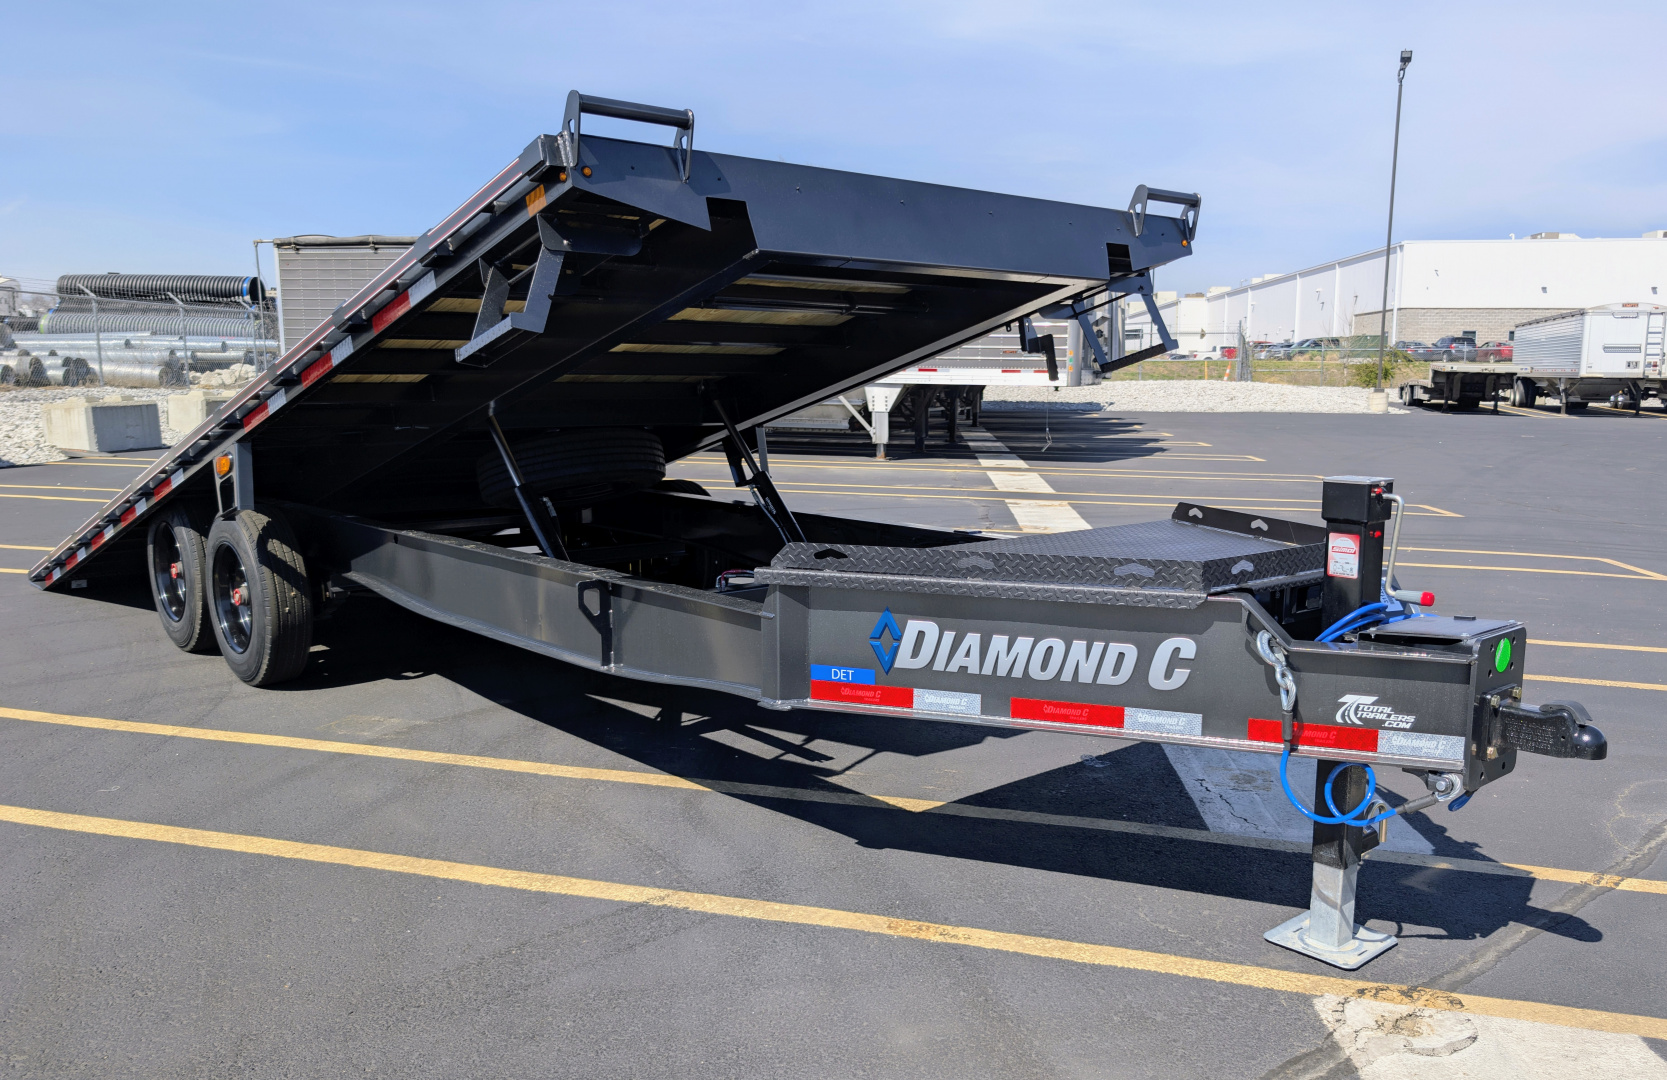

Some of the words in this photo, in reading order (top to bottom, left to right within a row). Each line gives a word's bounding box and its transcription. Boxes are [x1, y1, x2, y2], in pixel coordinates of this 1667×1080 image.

[894, 620, 1138, 686] DIAMOND
[1147, 637, 1197, 691] C
[831, 668, 855, 681] DET
[845, 687, 875, 698] DIAMOND
[875, 690, 882, 698] C
[929, 695, 960, 705] DIAMOND
[961, 698, 968, 706] C
[1048, 705, 1081, 717] DIAMOND
[1082, 708, 1089, 717] C
[1358, 704, 1395, 714] TOTAL
[1143, 714, 1178, 725] DIAMOND
[1179, 717, 1186, 726] C
[1356, 711, 1416, 722] TRAILERS
[1381, 720, 1412, 729] .COM
[1329, 731, 1337, 739] C
[1398, 736, 1437, 748] DIAMOND
[1438, 740, 1446, 749] C
